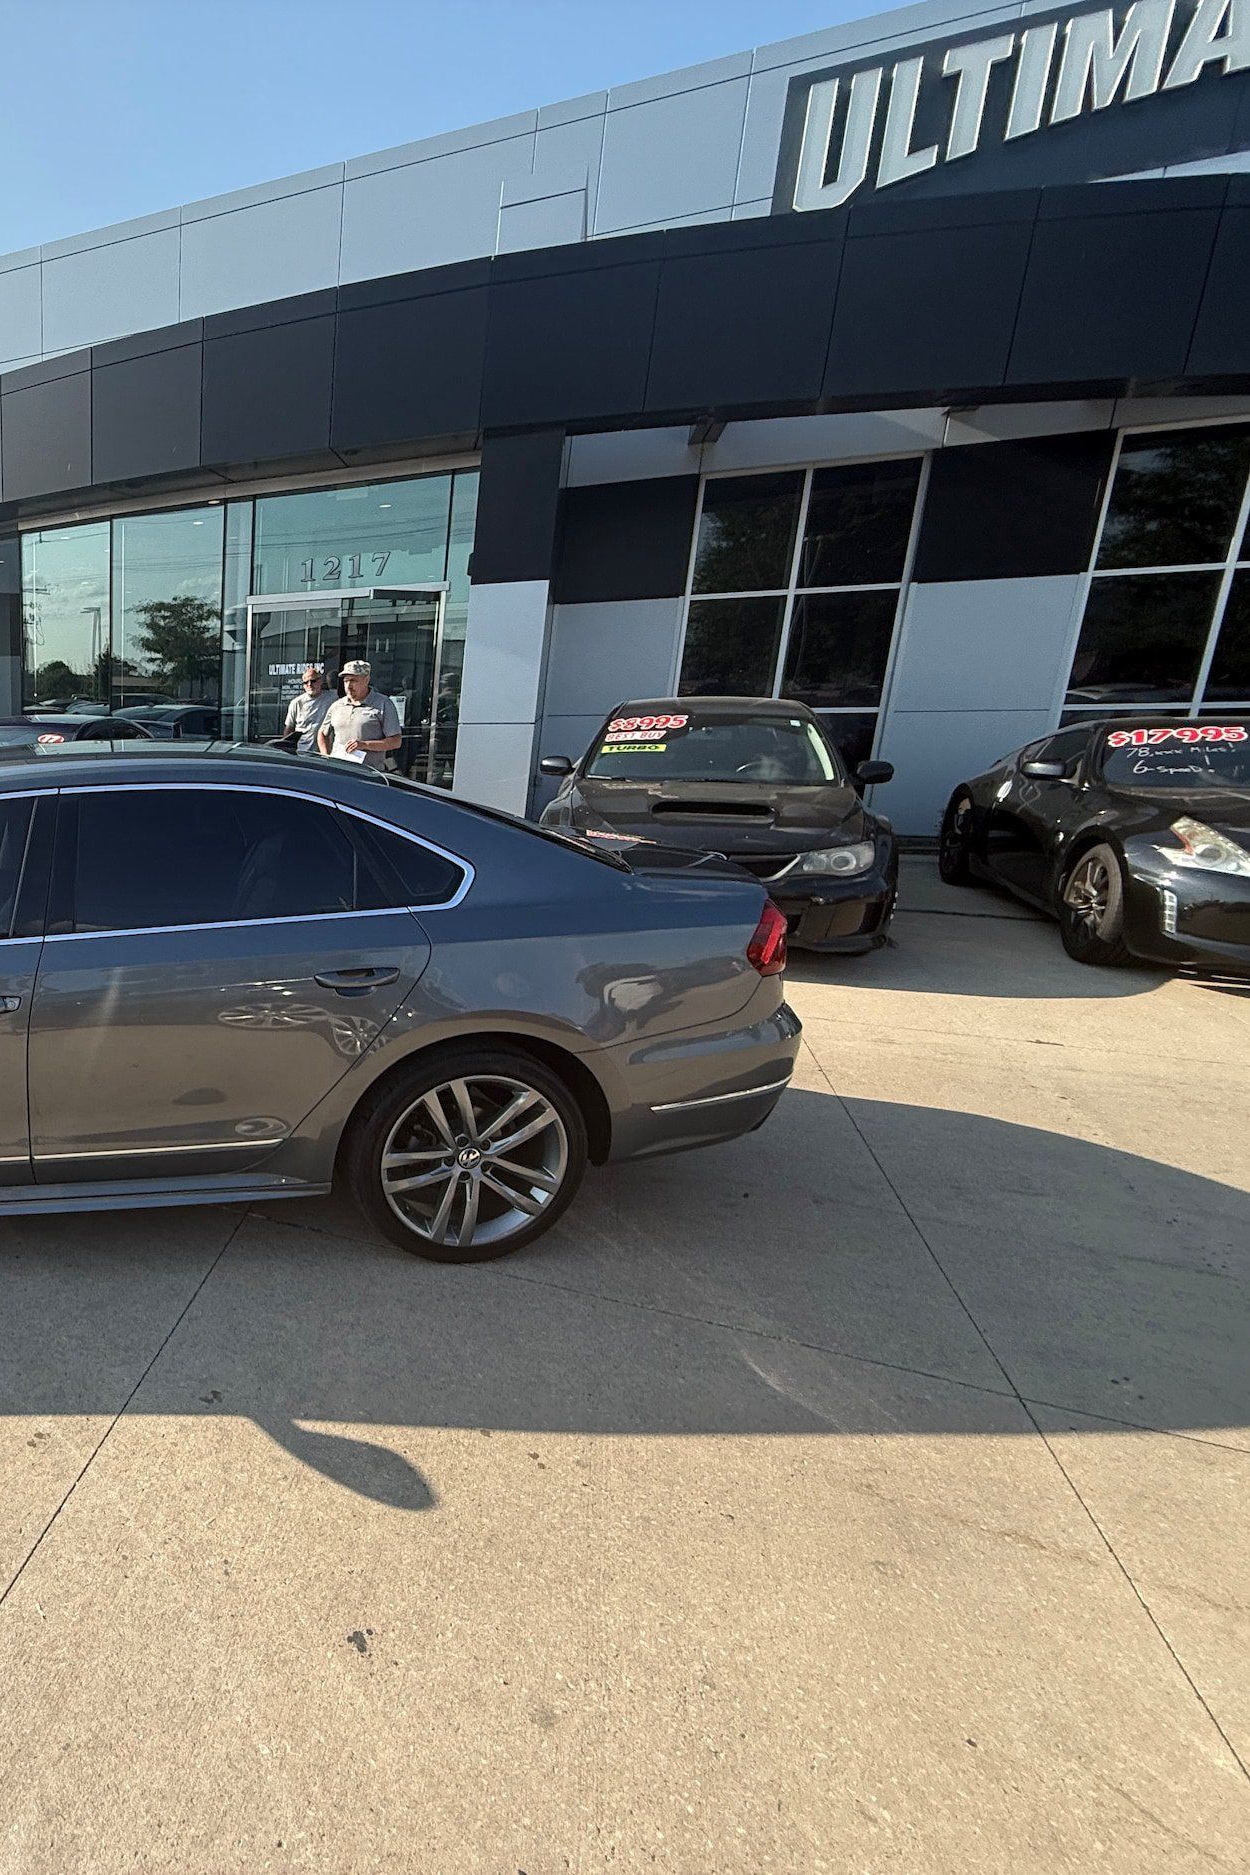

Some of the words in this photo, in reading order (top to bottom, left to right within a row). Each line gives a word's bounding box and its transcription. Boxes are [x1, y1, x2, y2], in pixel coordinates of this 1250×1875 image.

[793, 0, 1250, 212] ULTIMA
[301, 551, 391, 582] 1217
[269, 663, 296, 675] ULTIMATE
[608, 715, 689, 731] $8995
[607, 732, 635, 741] BEST
[640, 730, 665, 739] BUY
[1108, 726, 1248, 747] $17995
[608, 744, 660, 752] TURBO
